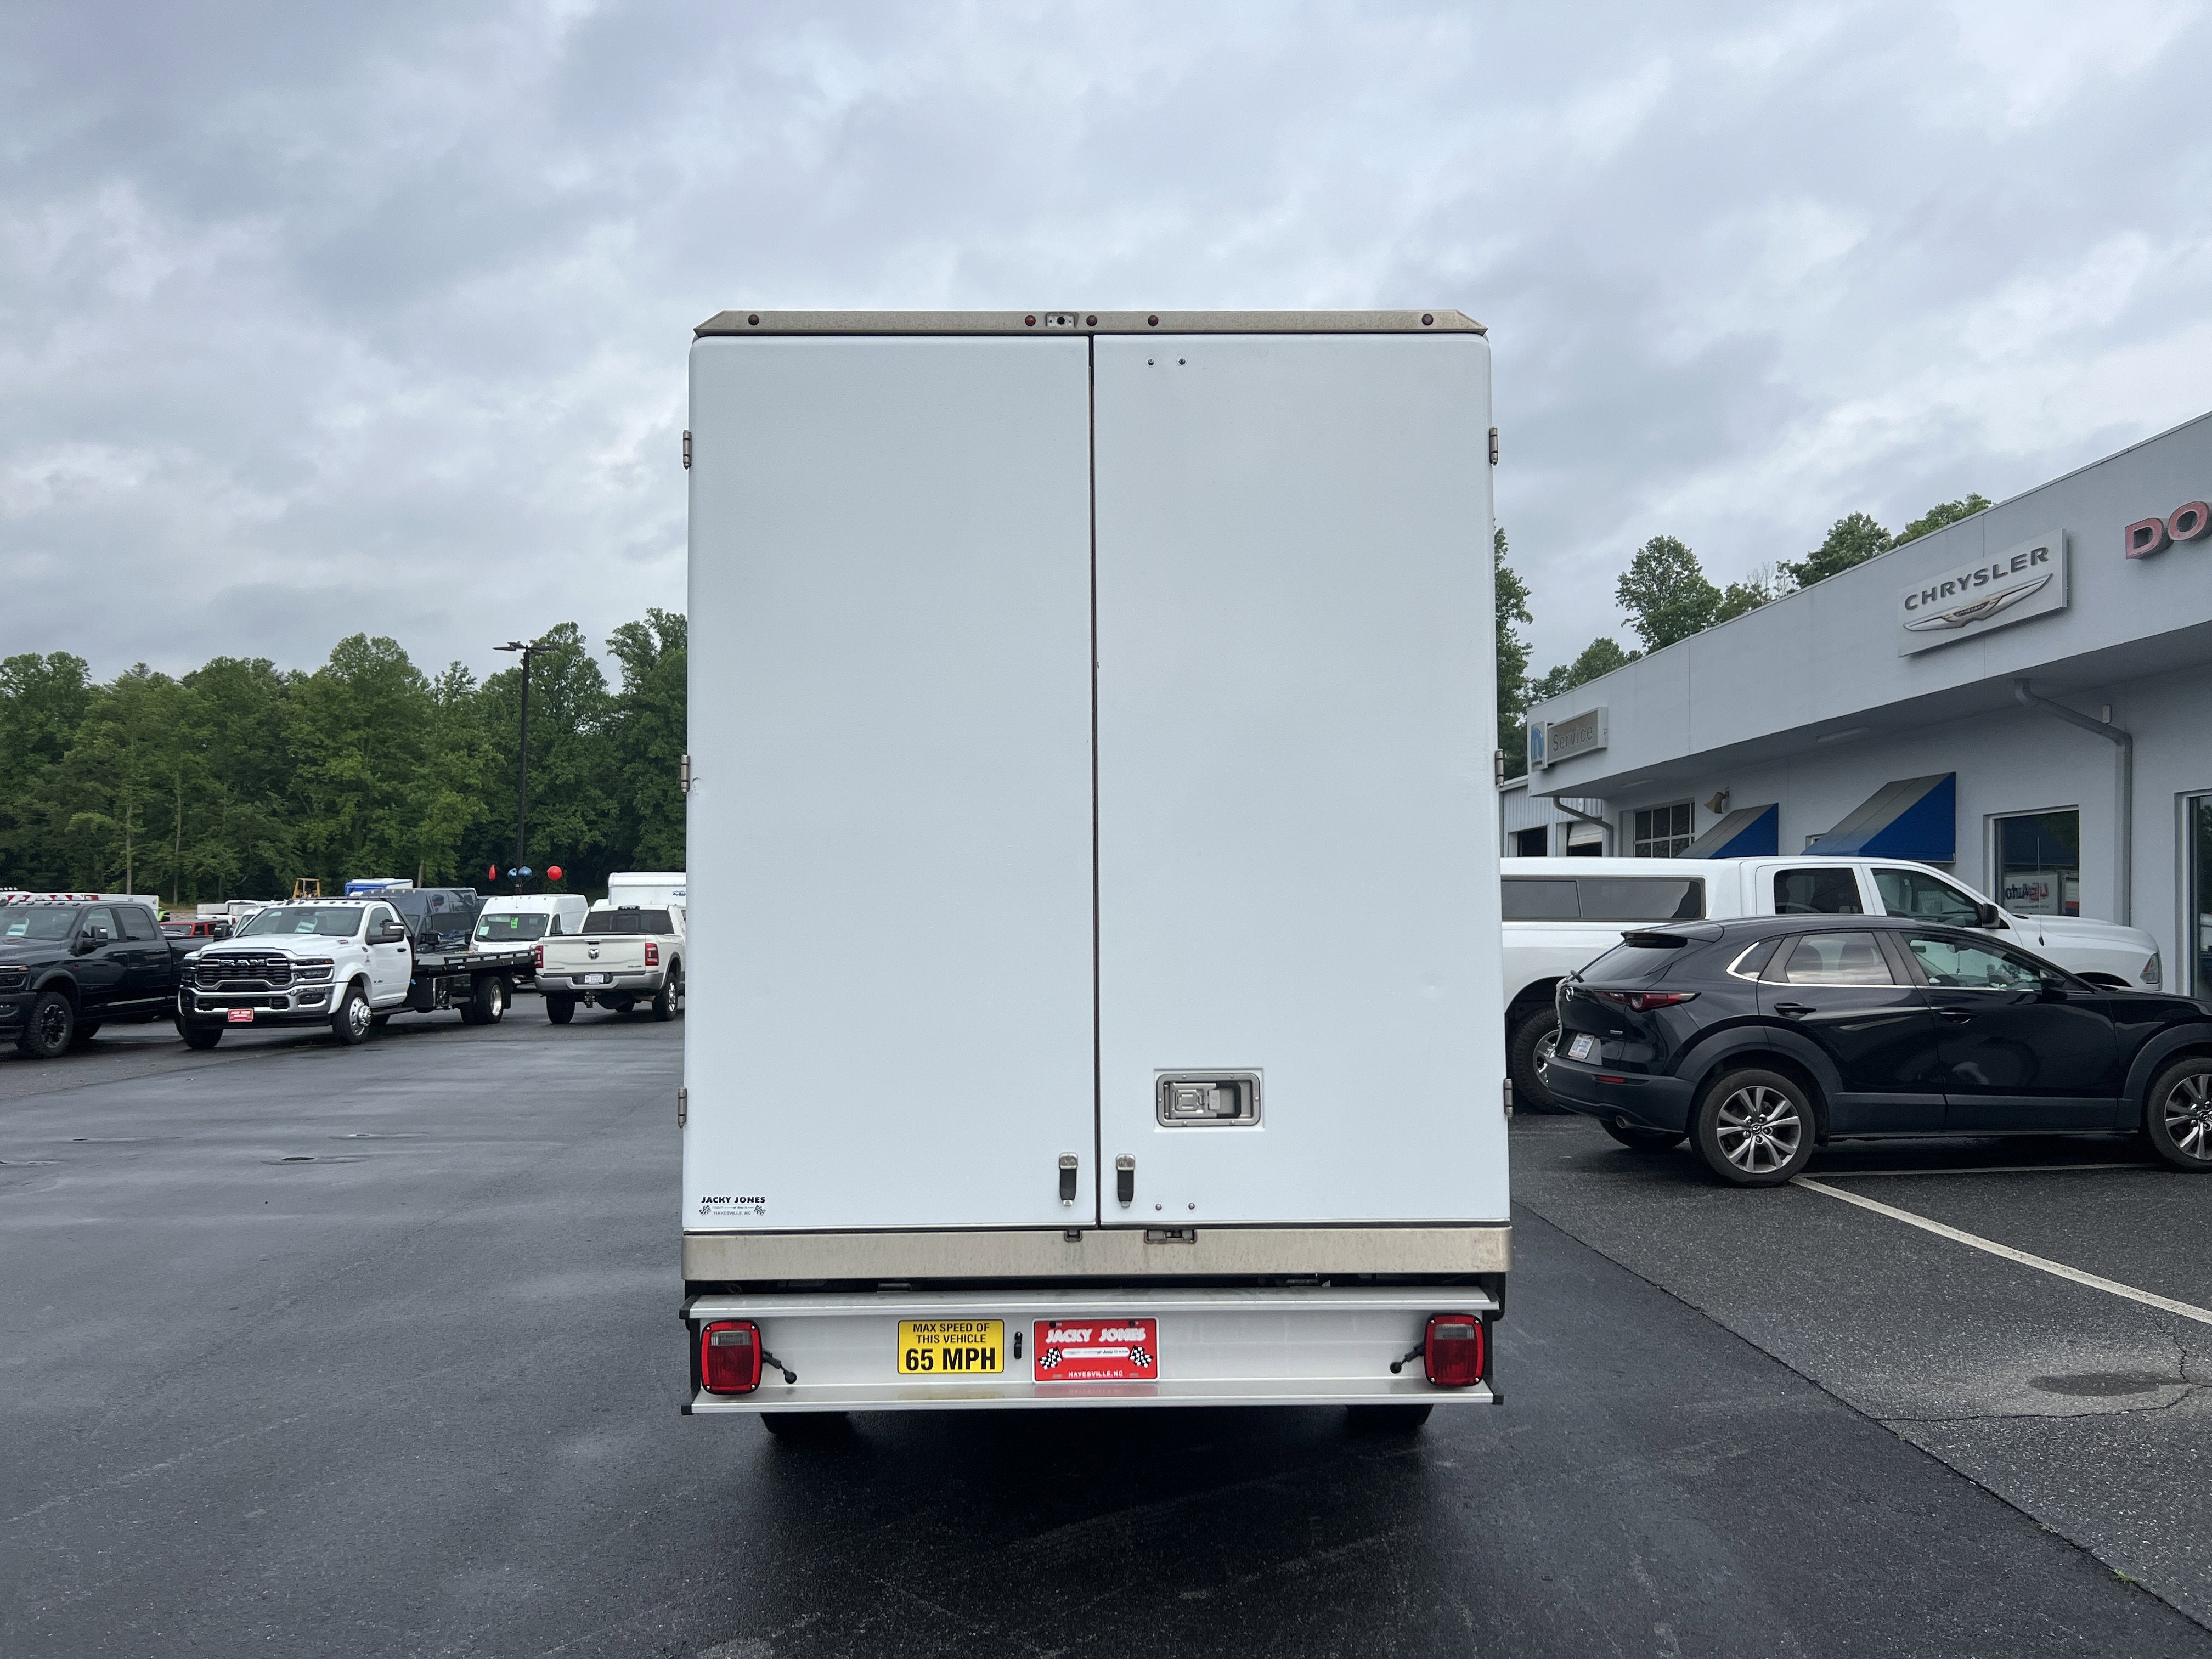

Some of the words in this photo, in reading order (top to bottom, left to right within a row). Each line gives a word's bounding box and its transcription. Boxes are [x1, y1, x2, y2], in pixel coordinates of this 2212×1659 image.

[1904, 547, 2049, 610] CHRYSLER
[1553, 726, 1593, 752] Service
[913, 1323, 936, 1333] MAX
[940, 1323, 973, 1333] SPEED
[976, 1323, 990, 1332] OF
[1045, 1328, 1093, 1344] JACKY
[1098, 1327, 1146, 1342] JONES
[916, 1334, 940, 1344] THIS
[943, 1334, 986, 1343] VEHICLE
[906, 1348, 933, 1371] 65
[943, 1347, 995, 1370] MPH
